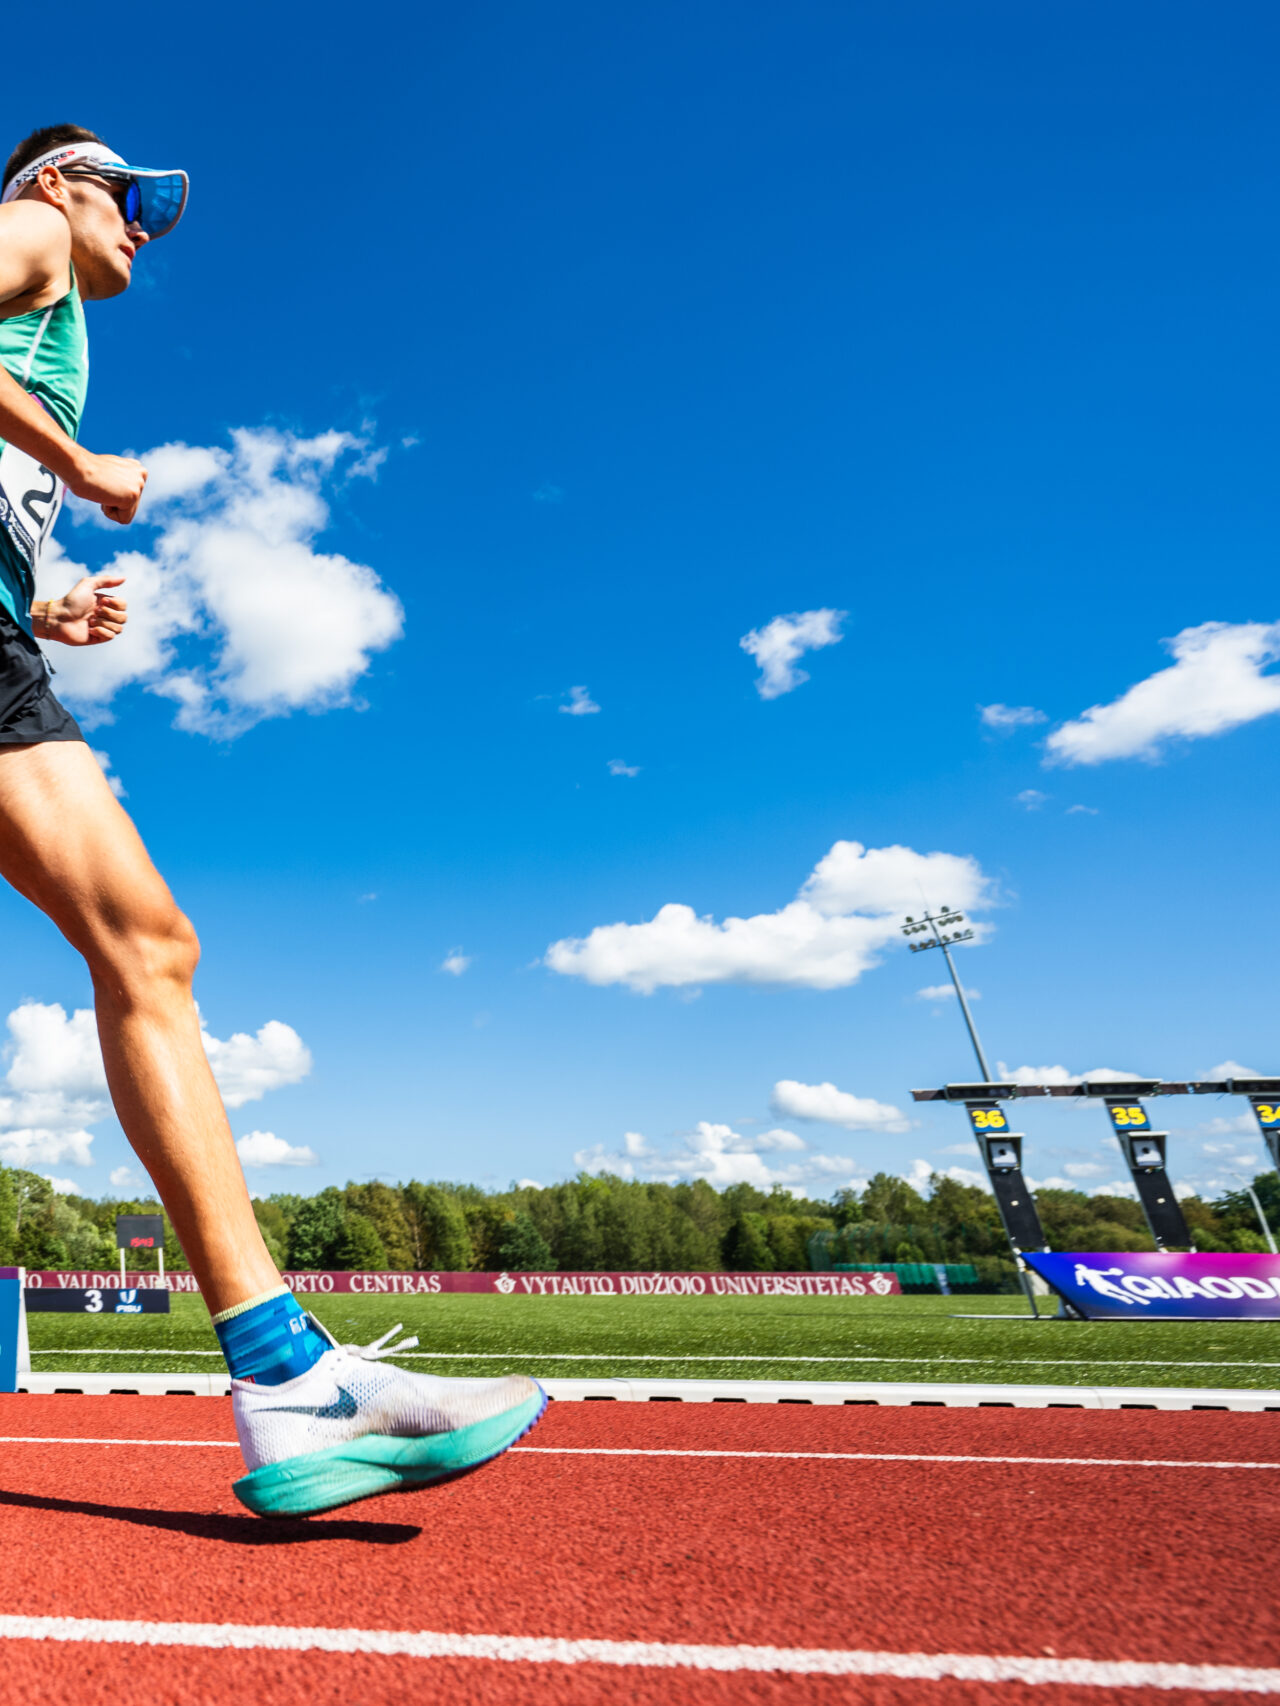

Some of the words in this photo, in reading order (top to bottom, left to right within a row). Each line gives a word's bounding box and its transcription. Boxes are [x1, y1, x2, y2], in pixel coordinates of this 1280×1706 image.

[972, 1110, 1006, 1128] 36
[1112, 1107, 1146, 1125] 35
[349, 1275, 441, 1293] CENTRAS
[521, 1276, 614, 1295] VYTAUTO
[710, 1276, 867, 1295] UNIVERSITETAS
[84, 1289, 104, 1313] 3
